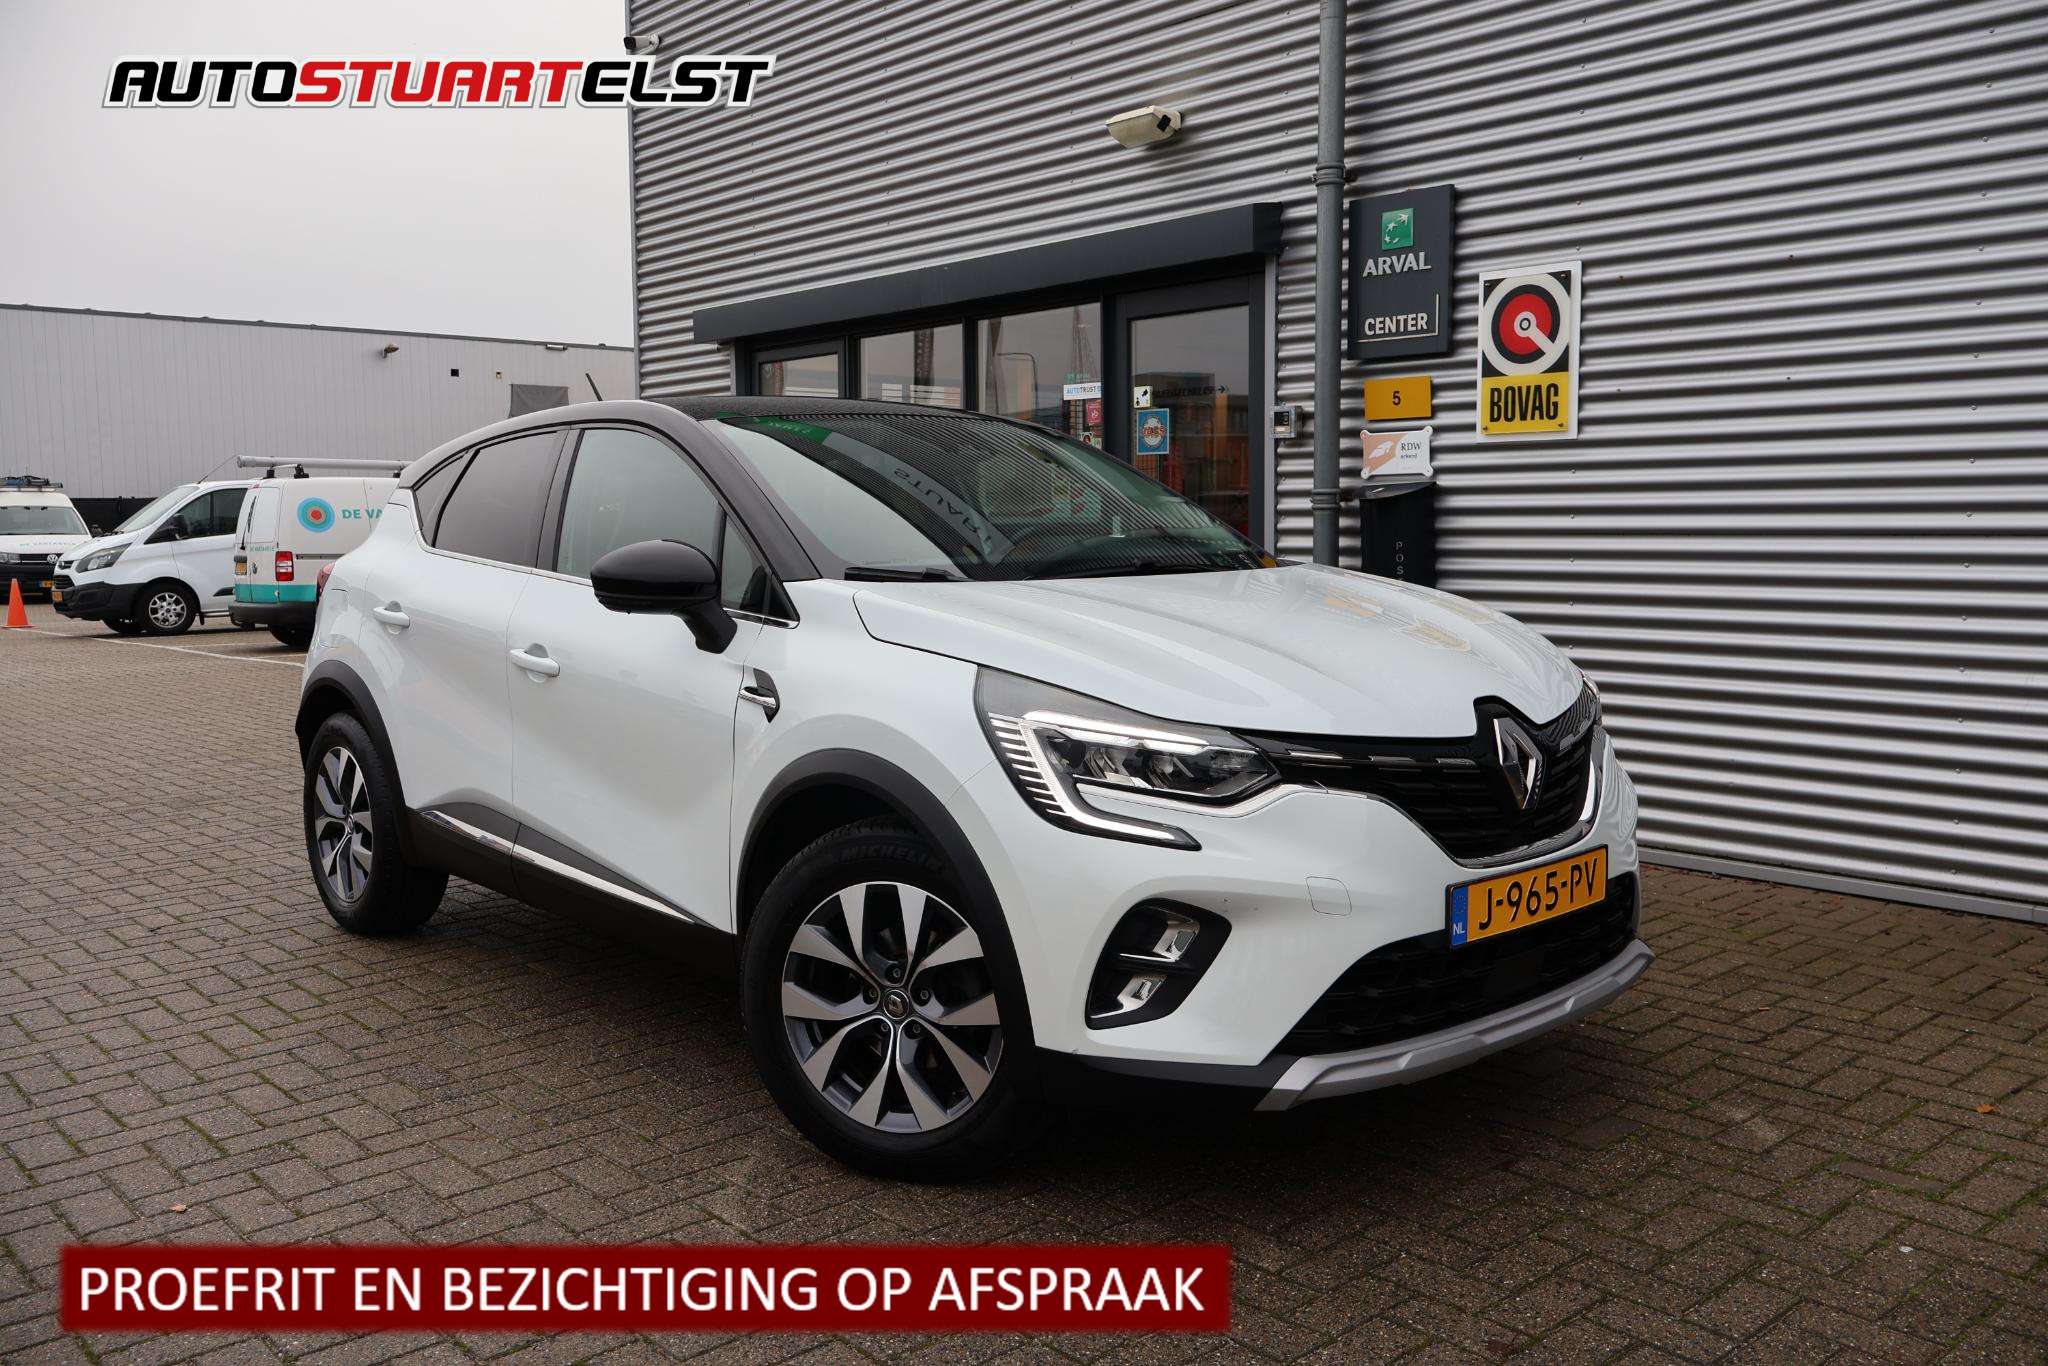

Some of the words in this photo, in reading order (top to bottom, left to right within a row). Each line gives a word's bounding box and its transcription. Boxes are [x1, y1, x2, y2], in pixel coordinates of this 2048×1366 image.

[1362, 251, 1432, 277] ARVAL
[1364, 312, 1429, 336] CENTER
[1392, 390, 1402, 406] 5
[1488, 382, 1560, 423] BOVAG
[1400, 441, 1422, 452] RDW
[341, 508, 362, 520] DE
[1395, 540, 1405, 581] POS
[1478, 857, 1599, 931] J-965-PV
[1452, 921, 1466, 936] NL
